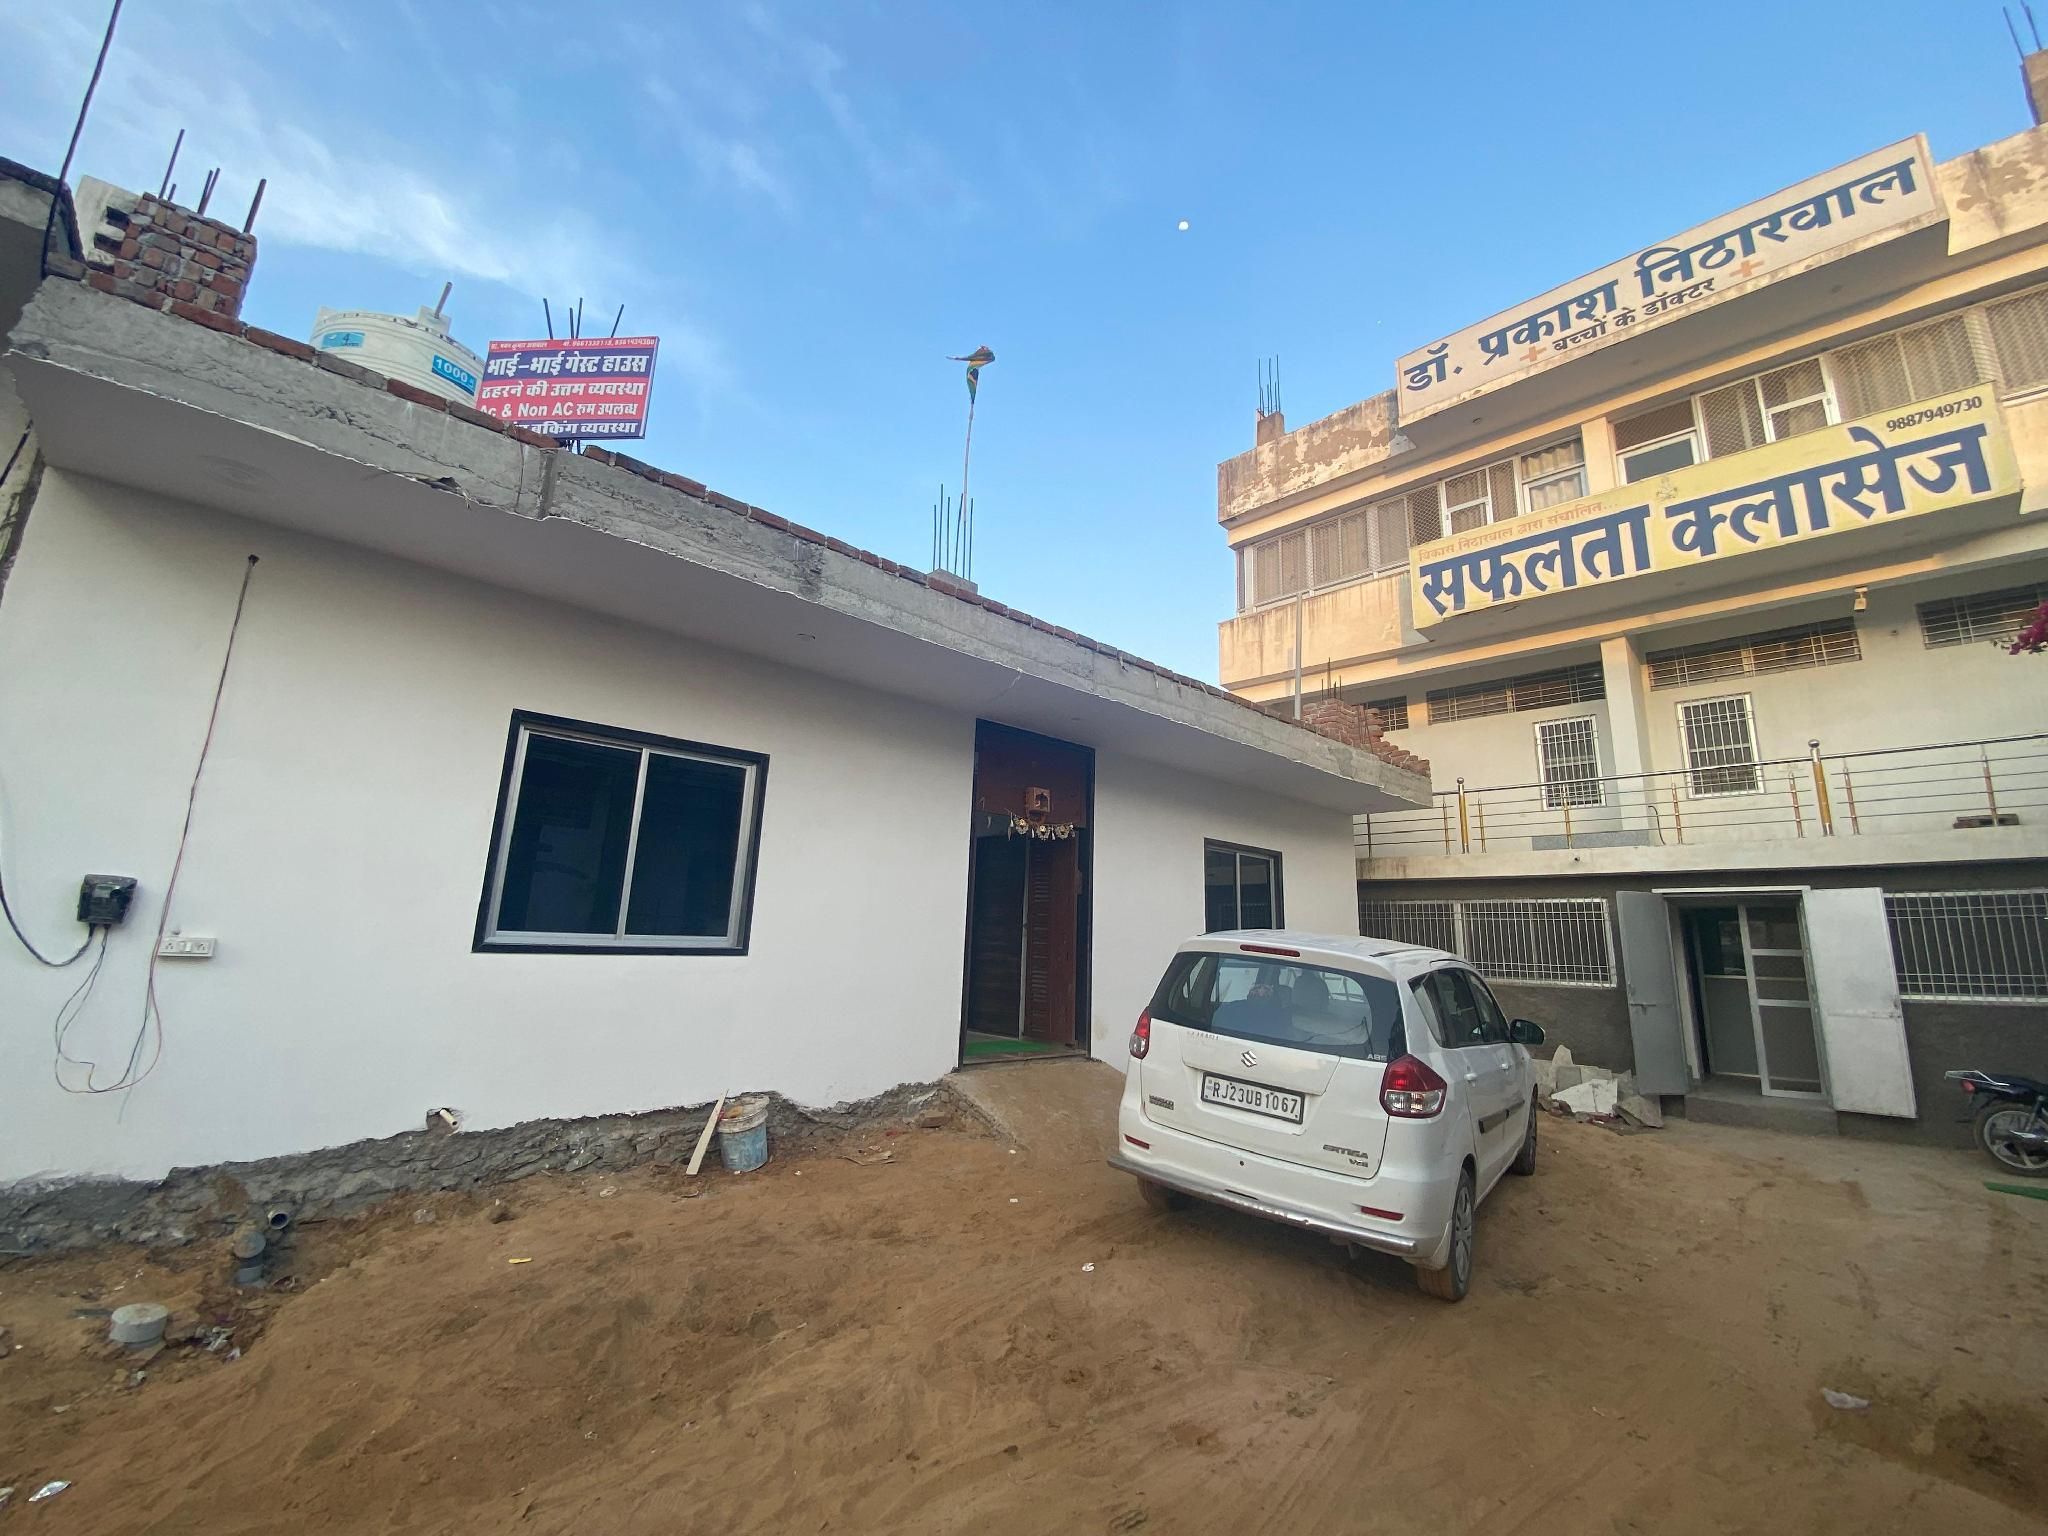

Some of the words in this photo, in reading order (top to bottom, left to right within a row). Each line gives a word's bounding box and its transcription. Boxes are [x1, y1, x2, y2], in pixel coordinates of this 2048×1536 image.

[1403, 342, 1463, 391] डॉ.
[1477, 279, 1619, 366] प्रकाश
[1634, 156, 1916, 298] निठारवाल
[1552, 315, 1607, 352] बच्चों
[1613, 306, 1636, 327] के
[1642, 277, 1715, 316] डॉक्टर
[487, 351, 565, 377] भाई-भाई
[564, 351, 601, 373] गेस्ट
[602, 355, 649, 373] हाउस
[482, 381, 524, 399] ठहरने
[526, 380, 550, 397] की
[588, 382, 648, 396] व्यवस्था
[501, 403, 512, 417] &
[518, 402, 548, 417] Non
[552, 402, 574, 416] AC
[597, 403, 639, 416] उपलब्ध
[1886, 396, 1983, 432] 9887949730
[580, 422, 639, 434] व्यवस्था
[1419, 503, 1651, 616] सफलता
[1664, 422, 1992, 557] क्लासेज
[1419, 544, 1455, 561] विकास
[1212, 1081, 1298, 1114] RJ23UB1067
